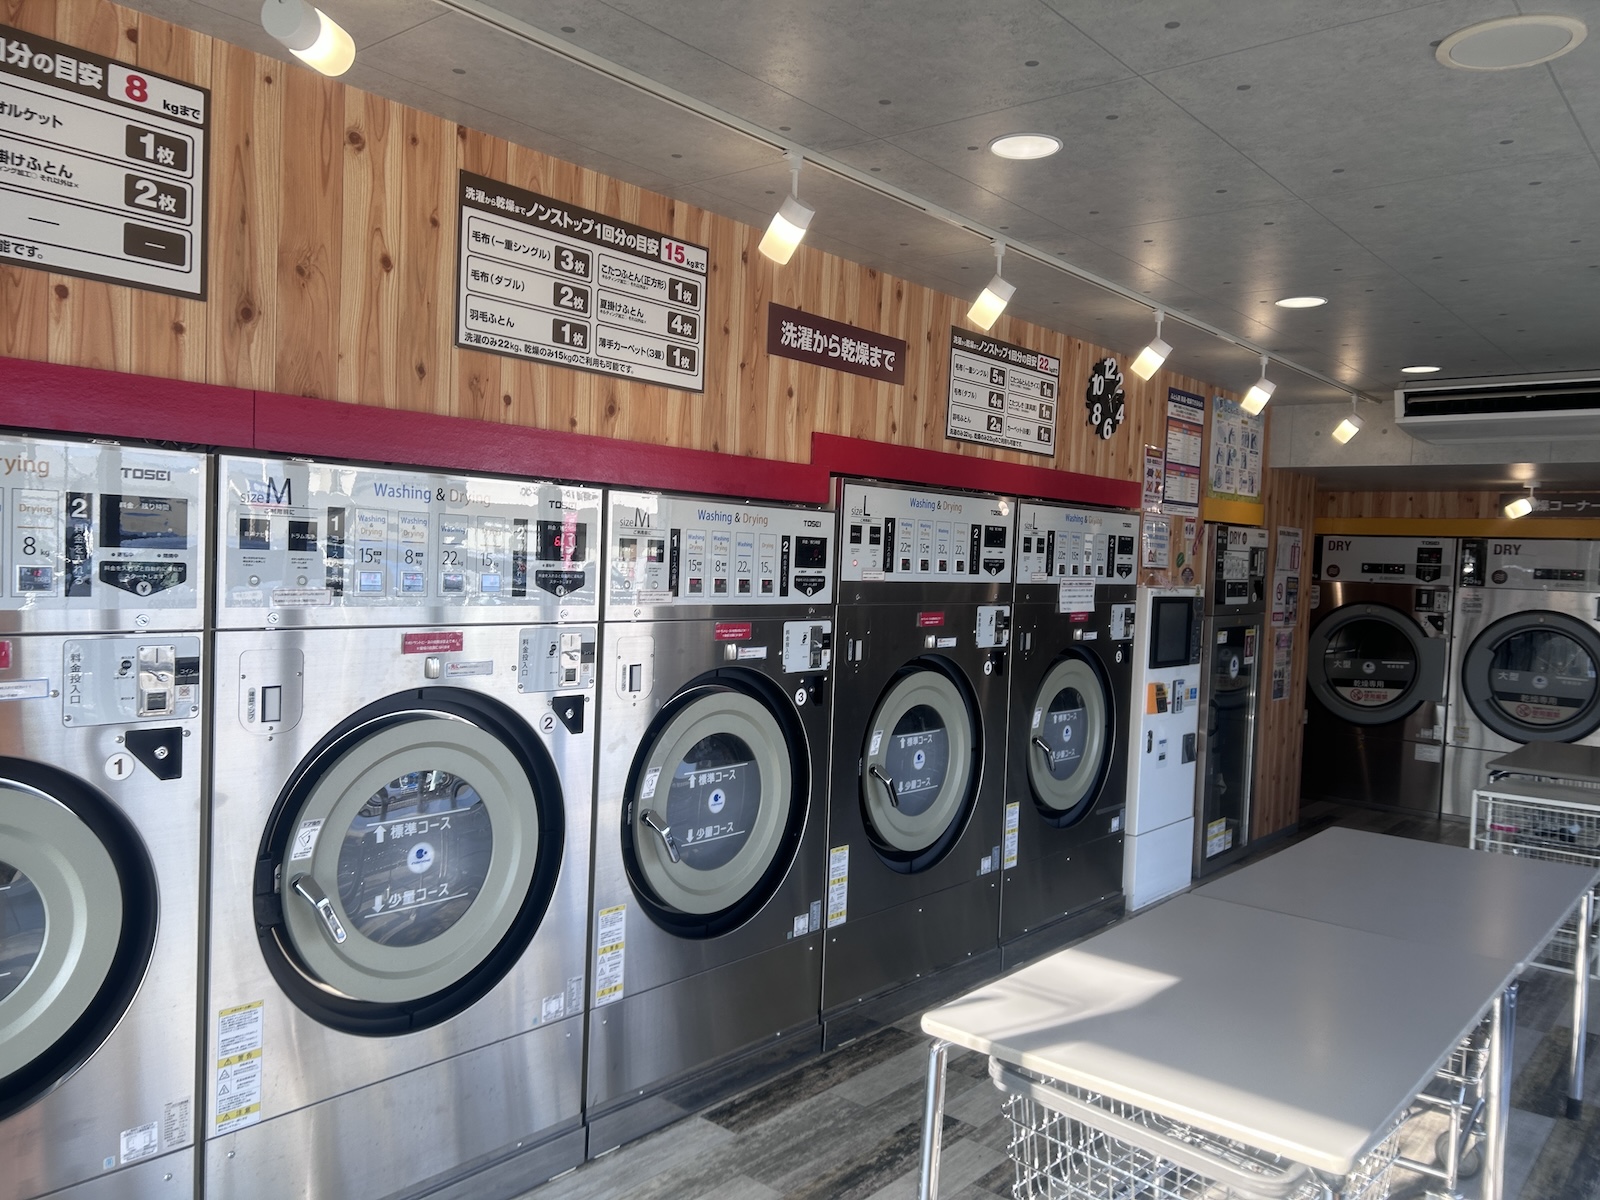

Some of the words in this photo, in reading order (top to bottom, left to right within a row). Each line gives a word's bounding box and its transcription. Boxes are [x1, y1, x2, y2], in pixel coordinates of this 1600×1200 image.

[0, 37, 103, 90] 分の目安
[125, 74, 148, 103] 8
[139, 132, 175, 166] 1枚
[134, 179, 176, 213] 2枚
[665, 242, 685, 264] 15
[560, 249, 585, 275] 3枚
[559, 286, 584, 310] 2枚
[674, 280, 692, 303] 1枚
[469, 308, 515, 328] 羽毛ふとん
[671, 314, 692, 336] 4枚
[561, 322, 584, 346] 1枚
[780, 320, 896, 372] 洗濯から乾燥まで
[673, 348, 691, 369] 1枚
[1104, 357, 1116, 379] 12
[1092, 373, 1104, 395] 10
[1116, 372, 1124, 394] 2
[1092, 402, 1102, 426] 8
[1116, 404, 1124, 424] 4
[1103, 418, 1113, 440] 6
[0, 455, 50, 478] ying
[120, 467, 171, 481] TOSEI
[240, 491, 264, 504] size
[267, 477, 292, 505] M
[374, 483, 431, 503] Washing
[436, 488, 446, 501] &
[449, 489, 491, 507] Drying
[18, 503, 52, 515] Drying
[71, 498, 88, 518] 2
[851, 506, 863, 516] size
[864, 495, 871, 517] L
[910, 498, 936, 511] Washing
[937, 501, 942, 510] &
[943, 501, 962, 514] Drying
[1532, 499, 1600, 512] 燥コーナー
[331, 516, 339, 531] 1
[358, 514, 386, 524] Washing
[400, 516, 428, 526] Washing
[620, 519, 634, 527] size
[635, 508, 650, 528] M
[698, 510, 732, 525] Washing
[735, 512, 741, 522] &
[743, 514, 768, 527] Drying
[1033, 512, 1038, 530] L
[1066, 514, 1083, 524] Washing
[360, 527, 382, 537] Drying
[403, 528, 424, 539] Drying
[887, 522, 892, 533] 1
[974, 529, 978, 538] 2
[672, 535, 677, 546] 1
[738, 541, 753, 550] Washing
[762, 542, 774, 550] Drying
[1230, 531, 1242, 545] DRY
[1328, 540, 1352, 551] DRY
[23, 536, 36, 555] 8
[40, 549, 50, 557] kg
[783, 541, 788, 552] 2
[900, 542, 908, 553] 22
[1494, 544, 1521, 556] DRY
[359, 548, 373, 563] 15
[405, 549, 413, 564] 8
[442, 550, 457, 566] 22
[481, 552, 492, 566] 15
[688, 560, 696, 572] 15
[715, 561, 720, 572] 8
[738, 561, 747, 572] 22
[761, 562, 768, 573] 15
[986, 664, 990, 672] 4
[1334, 660, 1352, 668] 大型
[70, 653, 82, 705] 料金投入口
[1498, 672, 1520, 681] 大型
[798, 692, 804, 702] 3
[544, 717, 553, 730] 2
[114, 758, 122, 775] 1
[698, 769, 736, 786] 標準コース
[904, 777, 931, 792] 少量コース
[390, 816, 451, 840] 標準コース
[696, 821, 734, 840] 少量コース
[388, 883, 449, 908] 少量コース
